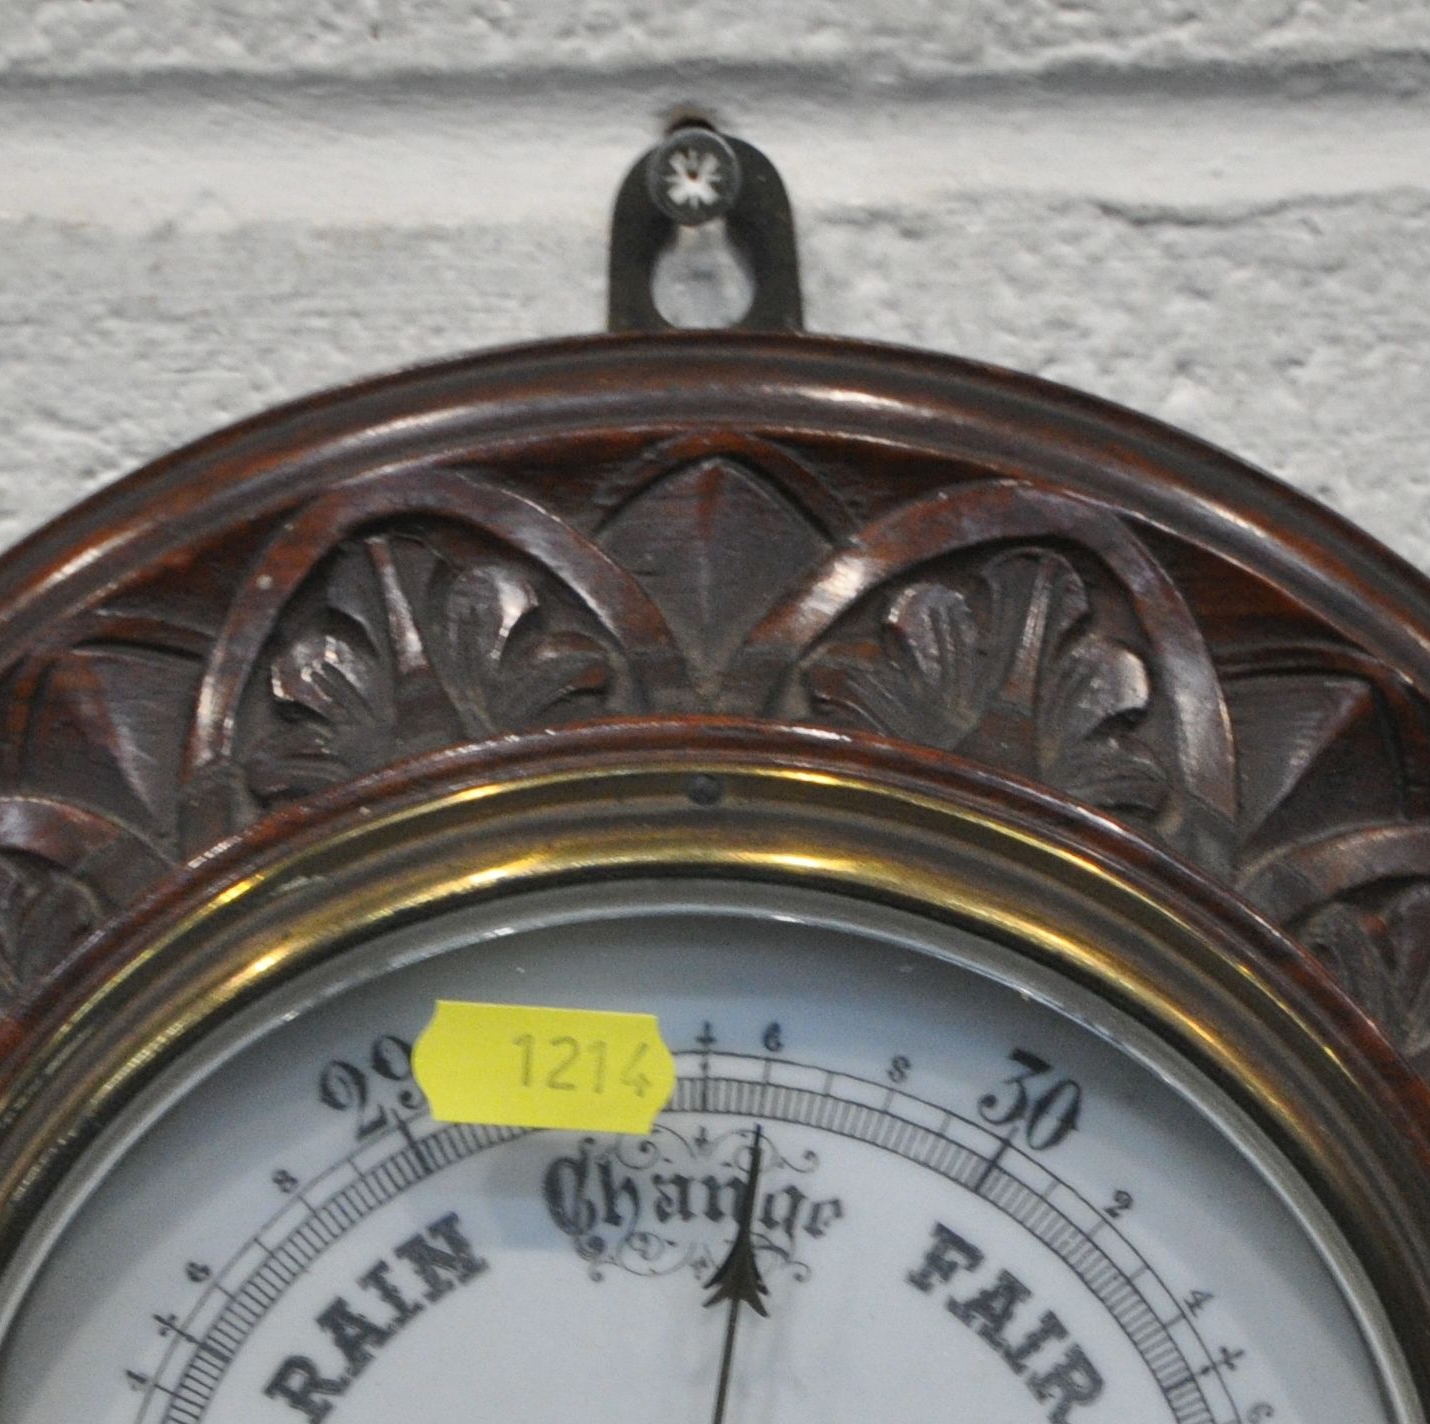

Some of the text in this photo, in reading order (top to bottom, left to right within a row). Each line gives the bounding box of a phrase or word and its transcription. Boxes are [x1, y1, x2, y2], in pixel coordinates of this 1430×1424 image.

[762, 1022, 784, 1052] 6
[512, 1032, 651, 1098] 1214
[978, 1048, 1082, 1151] 30
[543, 1137, 844, 1262] Change
[1104, 1189, 1134, 1218] 2
[184, 1261, 212, 1283] 6
[1183, 1289, 1214, 1318] 4
